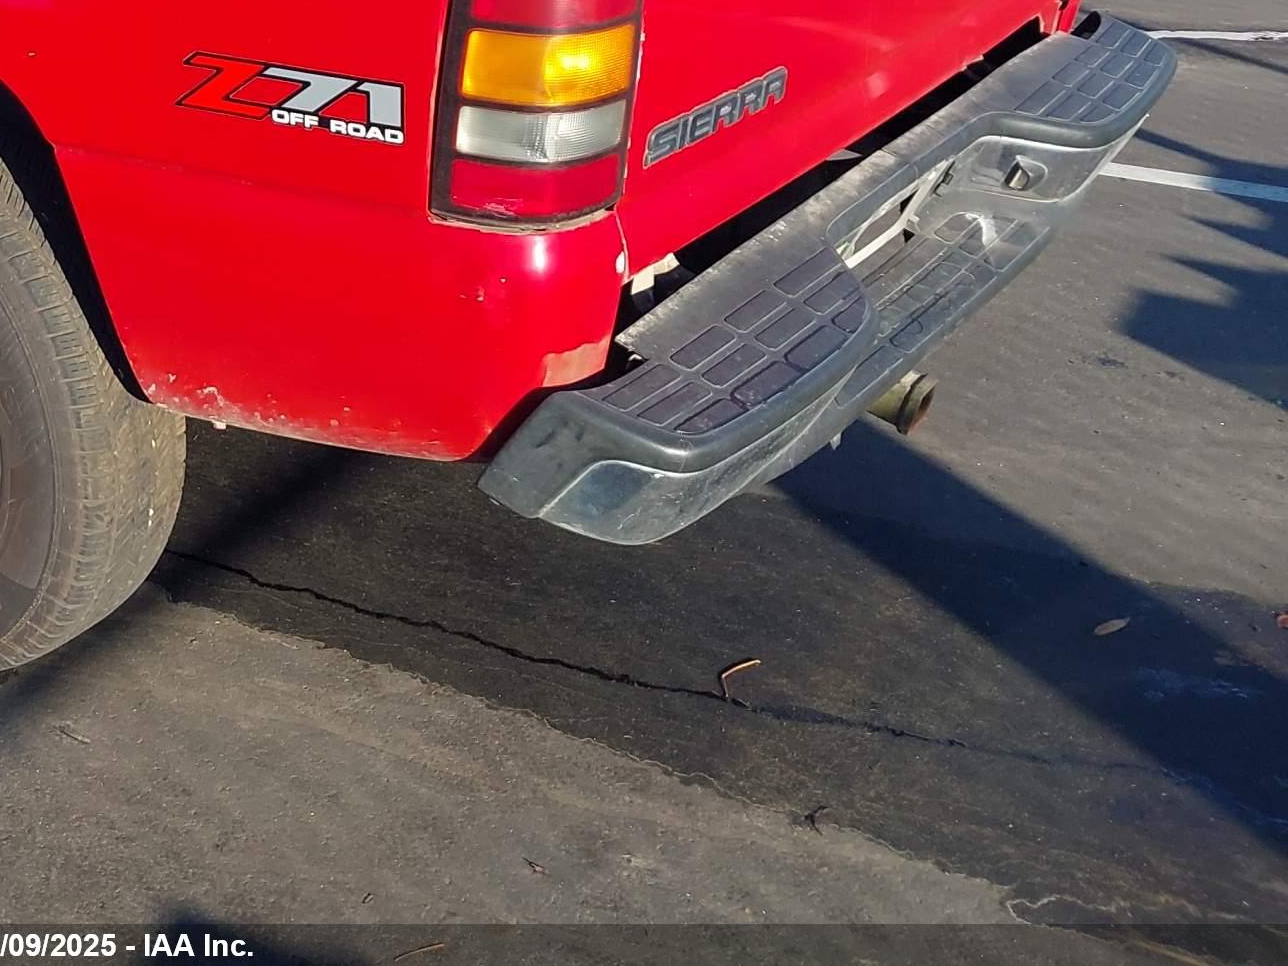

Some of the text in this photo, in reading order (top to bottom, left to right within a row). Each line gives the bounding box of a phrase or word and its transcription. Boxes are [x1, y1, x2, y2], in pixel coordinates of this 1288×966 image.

[174, 50, 405, 128] Z71
[271, 109, 405, 145] OFF ROAD
[643, 66, 789, 170] SIERRA
